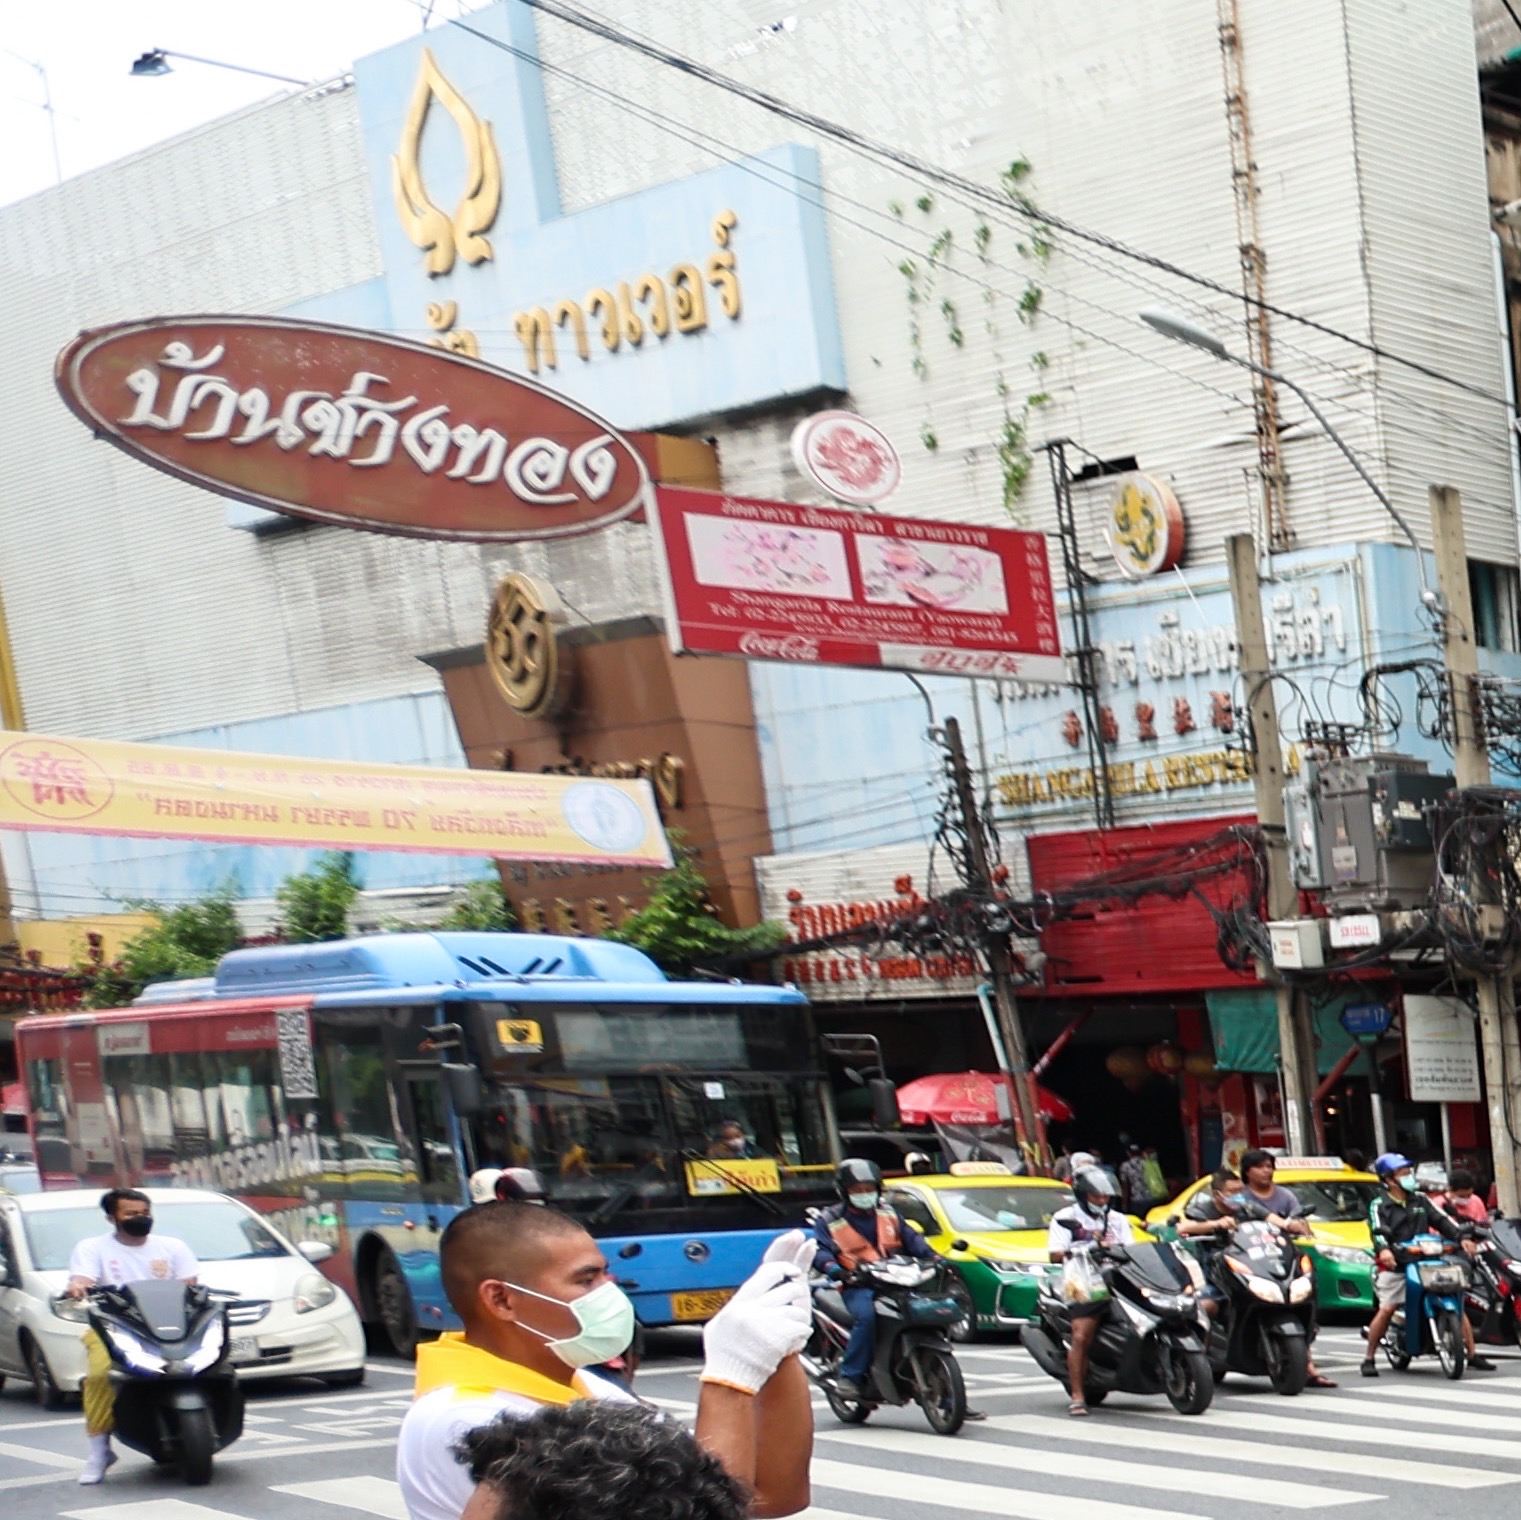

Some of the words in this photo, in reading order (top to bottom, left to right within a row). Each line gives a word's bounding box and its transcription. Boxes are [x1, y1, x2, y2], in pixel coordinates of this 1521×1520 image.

[514, 209, 742, 375] ทาวเวอร์
[119, 340, 620, 507] บ้านช่างทอง
